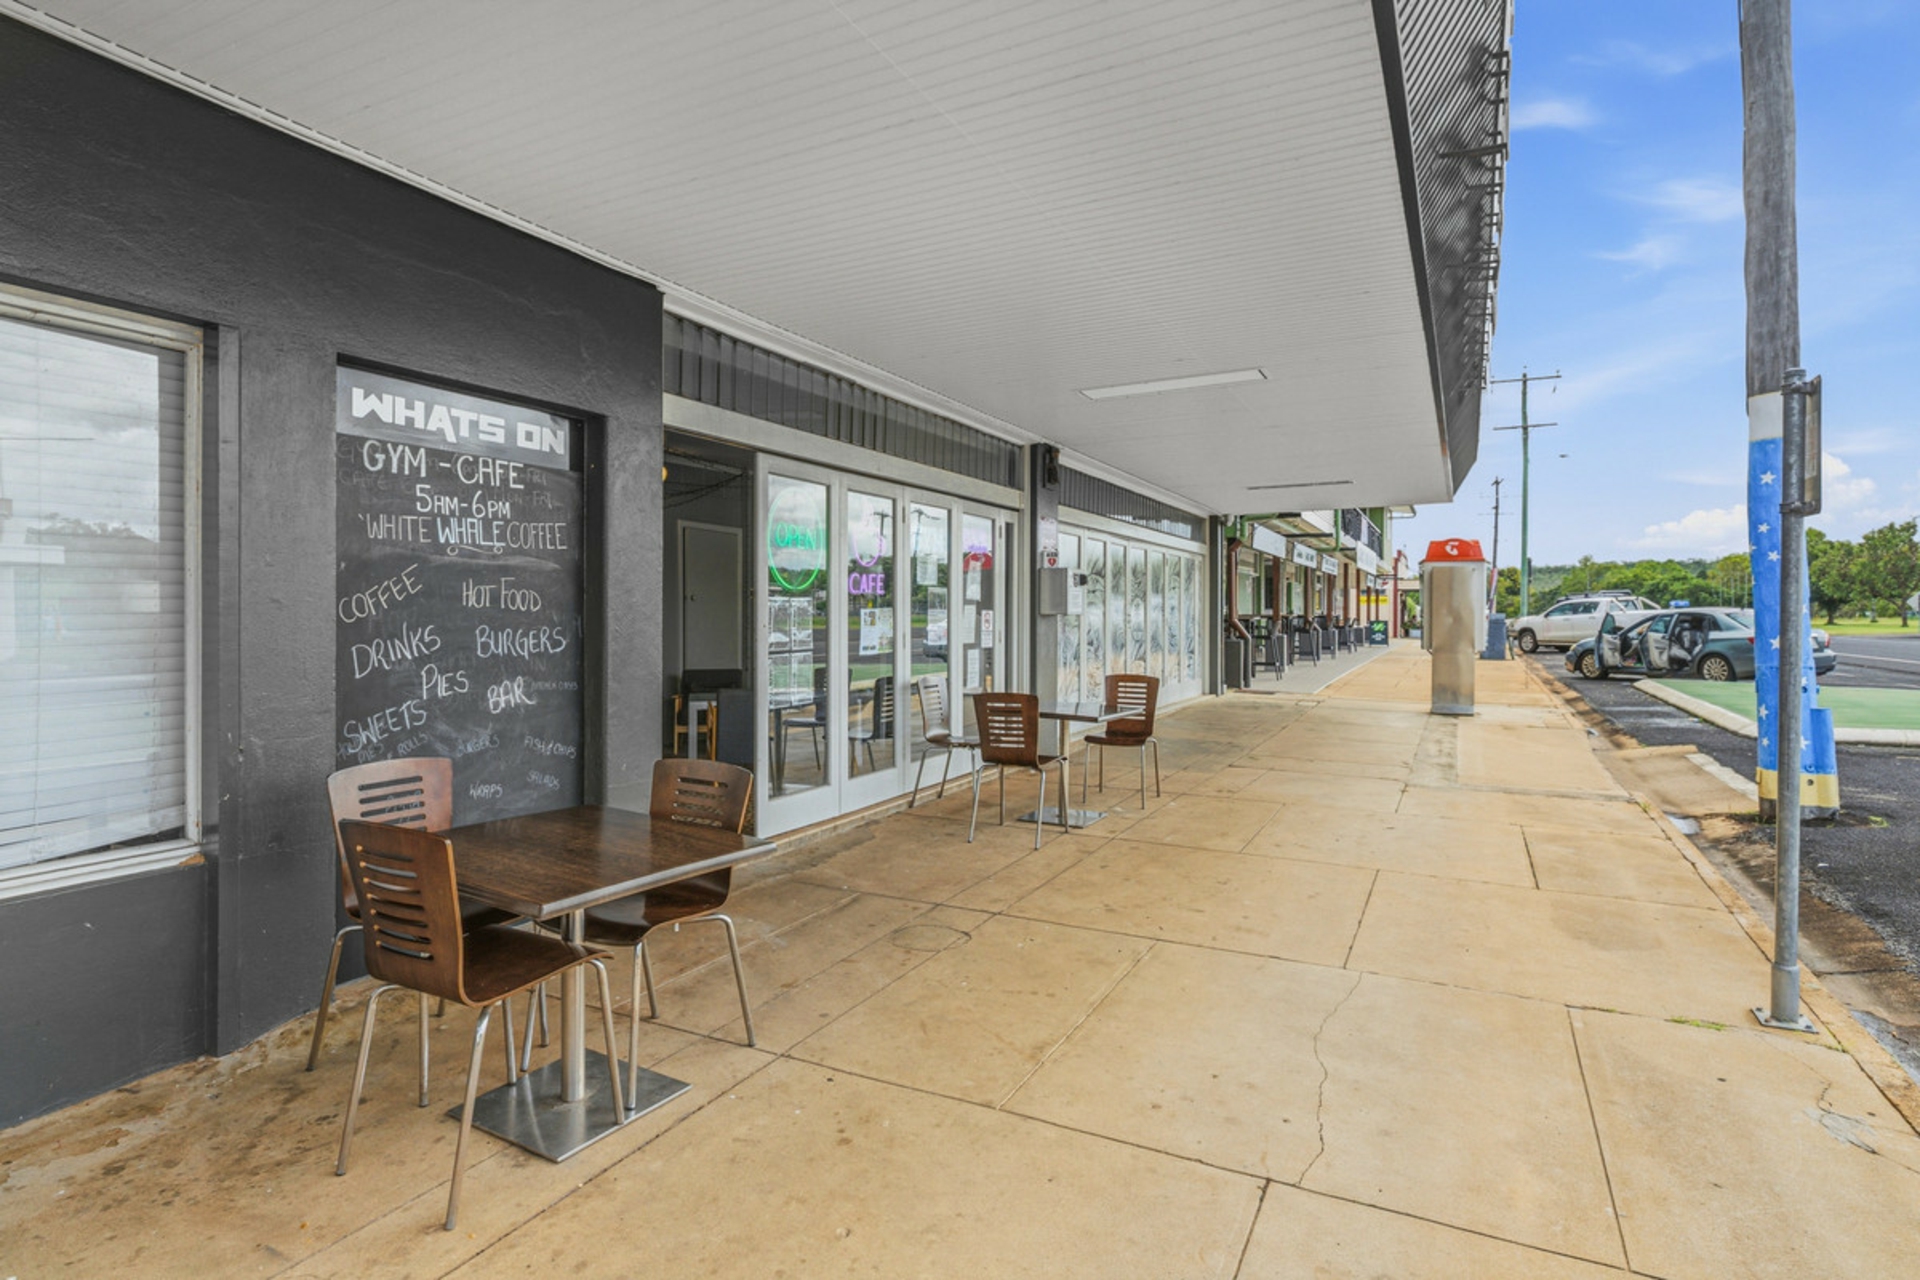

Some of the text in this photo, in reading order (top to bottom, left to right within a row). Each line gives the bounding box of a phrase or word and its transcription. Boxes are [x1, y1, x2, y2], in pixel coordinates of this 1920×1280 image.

[351, 387, 565, 455] WHATS ON
[362, 439, 427, 478] GYM
[436, 517, 506, 547] WHALE
[507, 521, 568, 550] COFFEE
[774, 522, 817, 550] OPEN
[338, 563, 423, 624] COFFEE
[462, 577, 541, 612] HOT FOOD
[848, 572, 886, 595] CAFE
[351, 622, 441, 680] DRINKS
[476, 624, 568, 660] BURGERS
[420, 663, 469, 700] PIES
[487, 677, 535, 714] BAR
[343, 699, 428, 753] SWEETS
